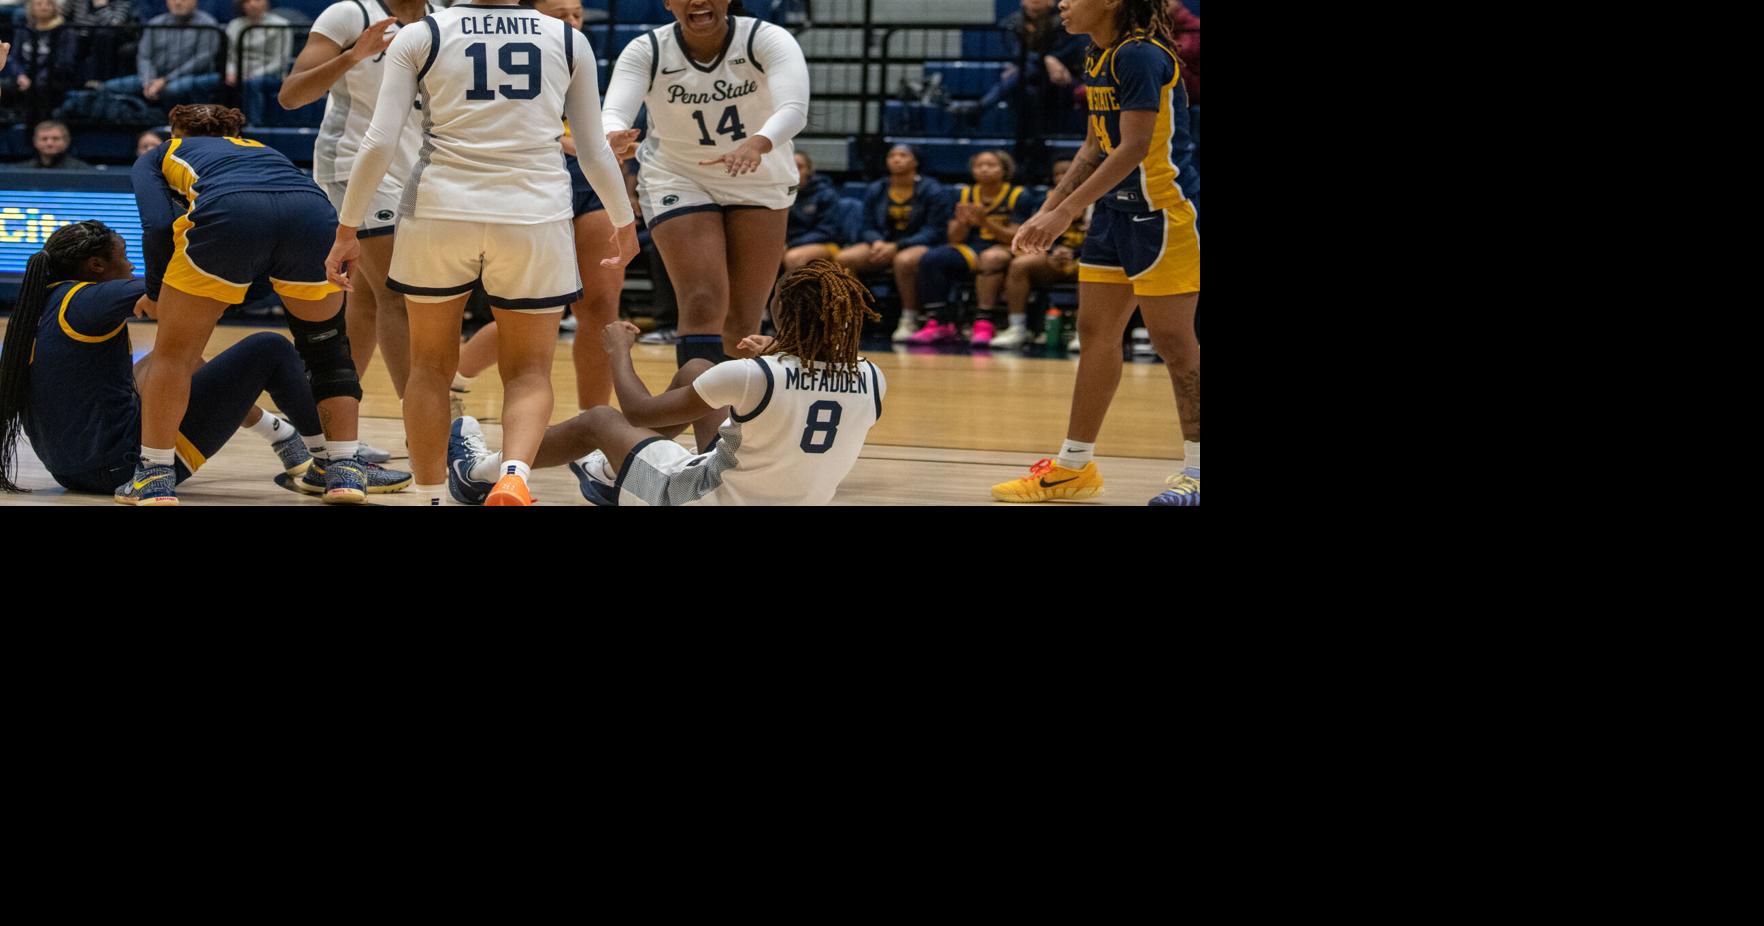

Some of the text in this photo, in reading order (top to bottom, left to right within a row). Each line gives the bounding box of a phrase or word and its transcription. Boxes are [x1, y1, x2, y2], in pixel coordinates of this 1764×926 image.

[461, 14, 542, 35] CLÉANTE
[465, 42, 542, 100] 19
[667, 80, 758, 104] Penn State
[692, 105, 747, 146] 14
[0, 207, 82, 243] Cit
[800, 400, 843, 454] 8
